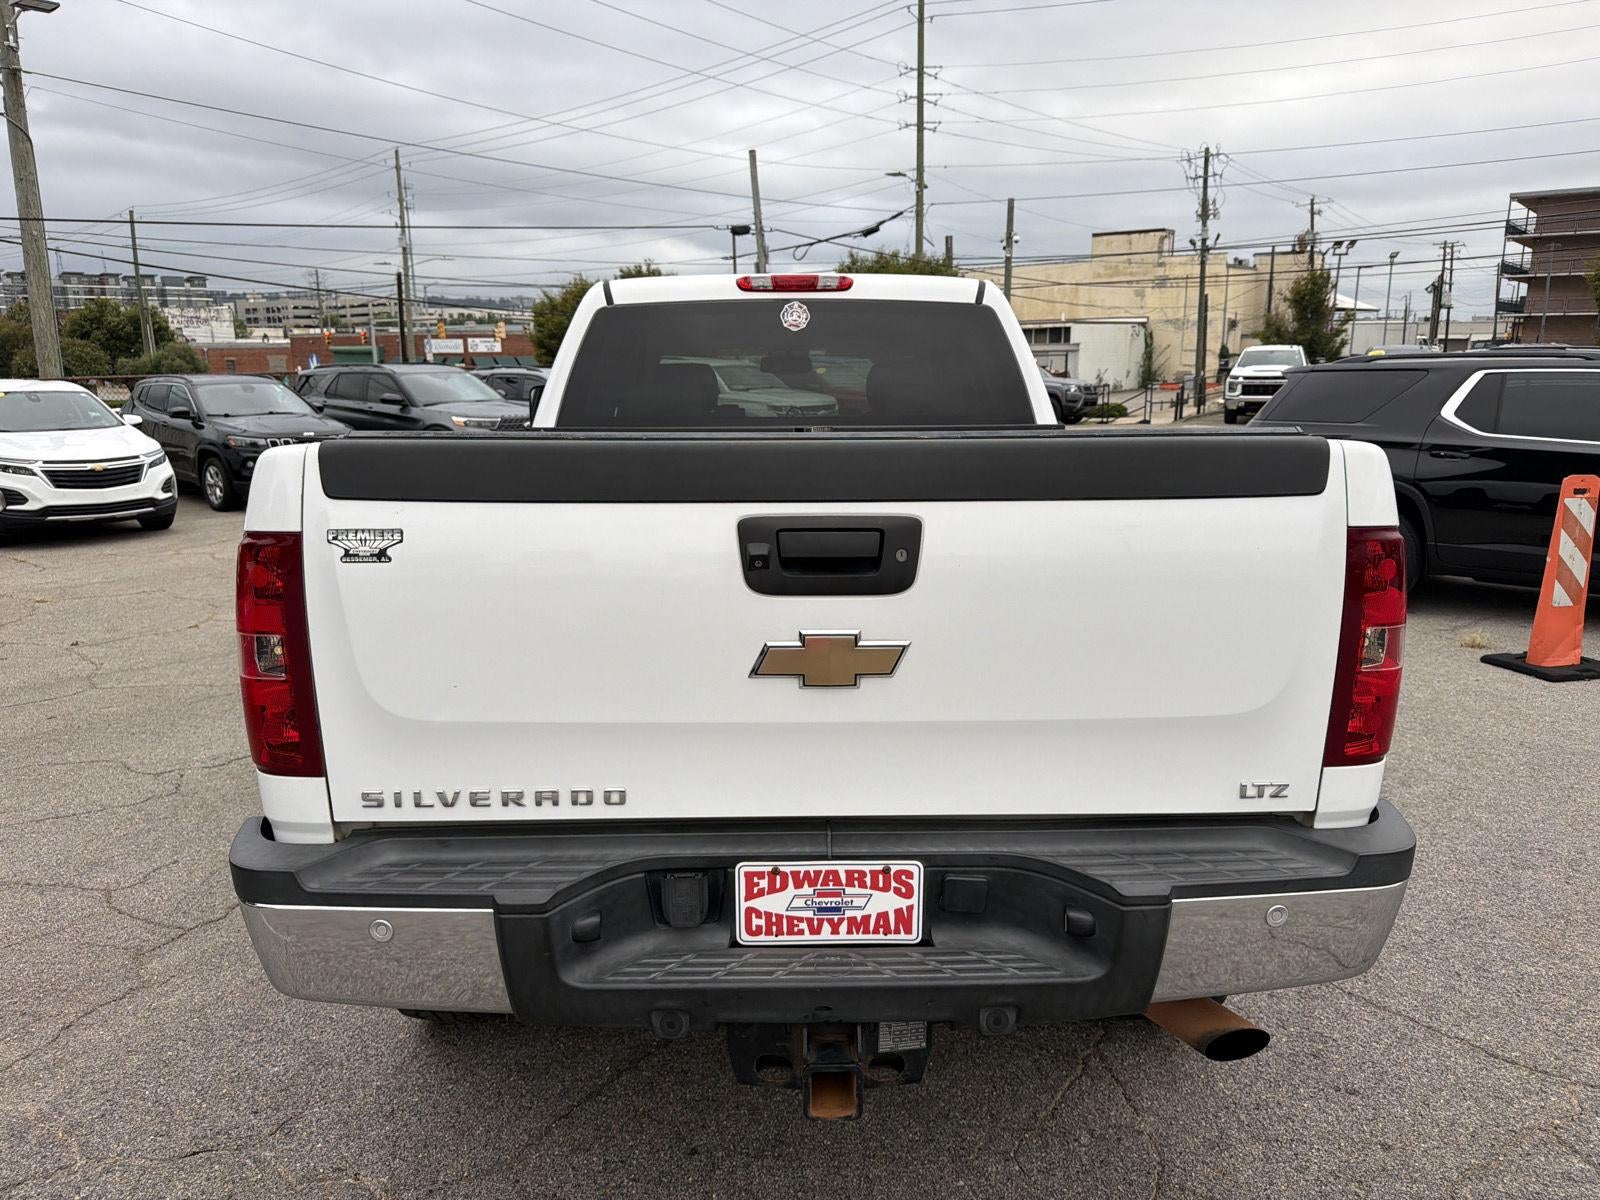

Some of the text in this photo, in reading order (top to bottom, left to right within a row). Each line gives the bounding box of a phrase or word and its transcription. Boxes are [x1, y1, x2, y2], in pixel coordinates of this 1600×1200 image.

[327, 528, 402, 540] PREMIERE
[361, 787, 627, 808] SILVERADO
[1239, 782, 1290, 799] LTZ
[744, 869, 915, 902] EDWARDS
[804, 898, 854, 907] Chevrolet
[744, 904, 914, 937] CHEVYMAN
